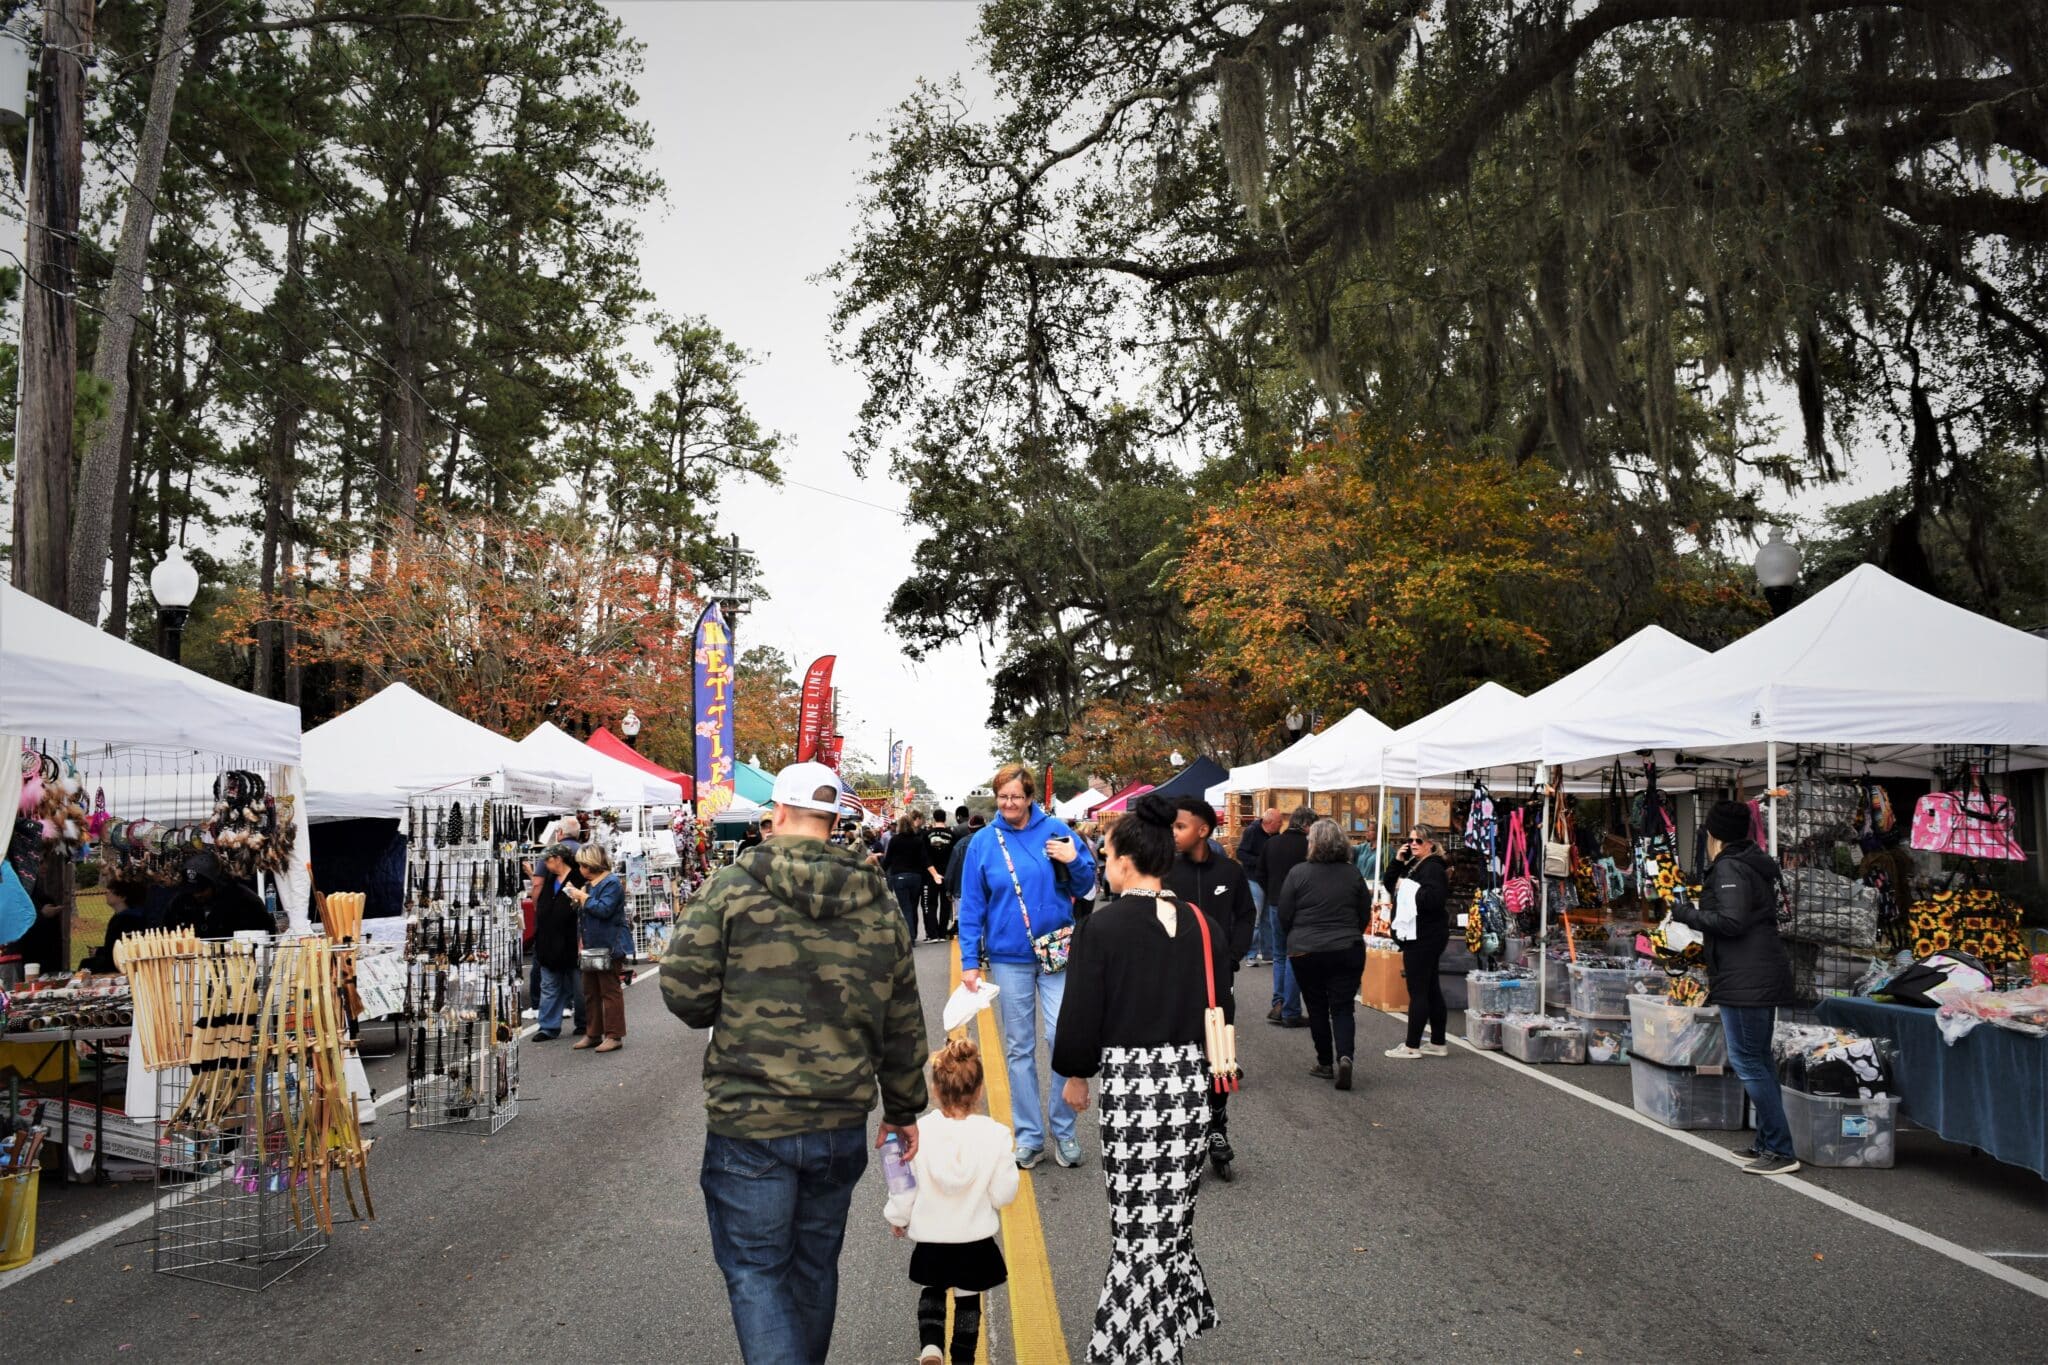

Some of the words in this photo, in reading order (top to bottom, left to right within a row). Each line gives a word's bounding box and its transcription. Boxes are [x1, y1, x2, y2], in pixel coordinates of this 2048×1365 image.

[808, 669, 824, 697] LINE
[805, 703, 819, 732] NINE
[856, 789, 893, 798] EMONADE
